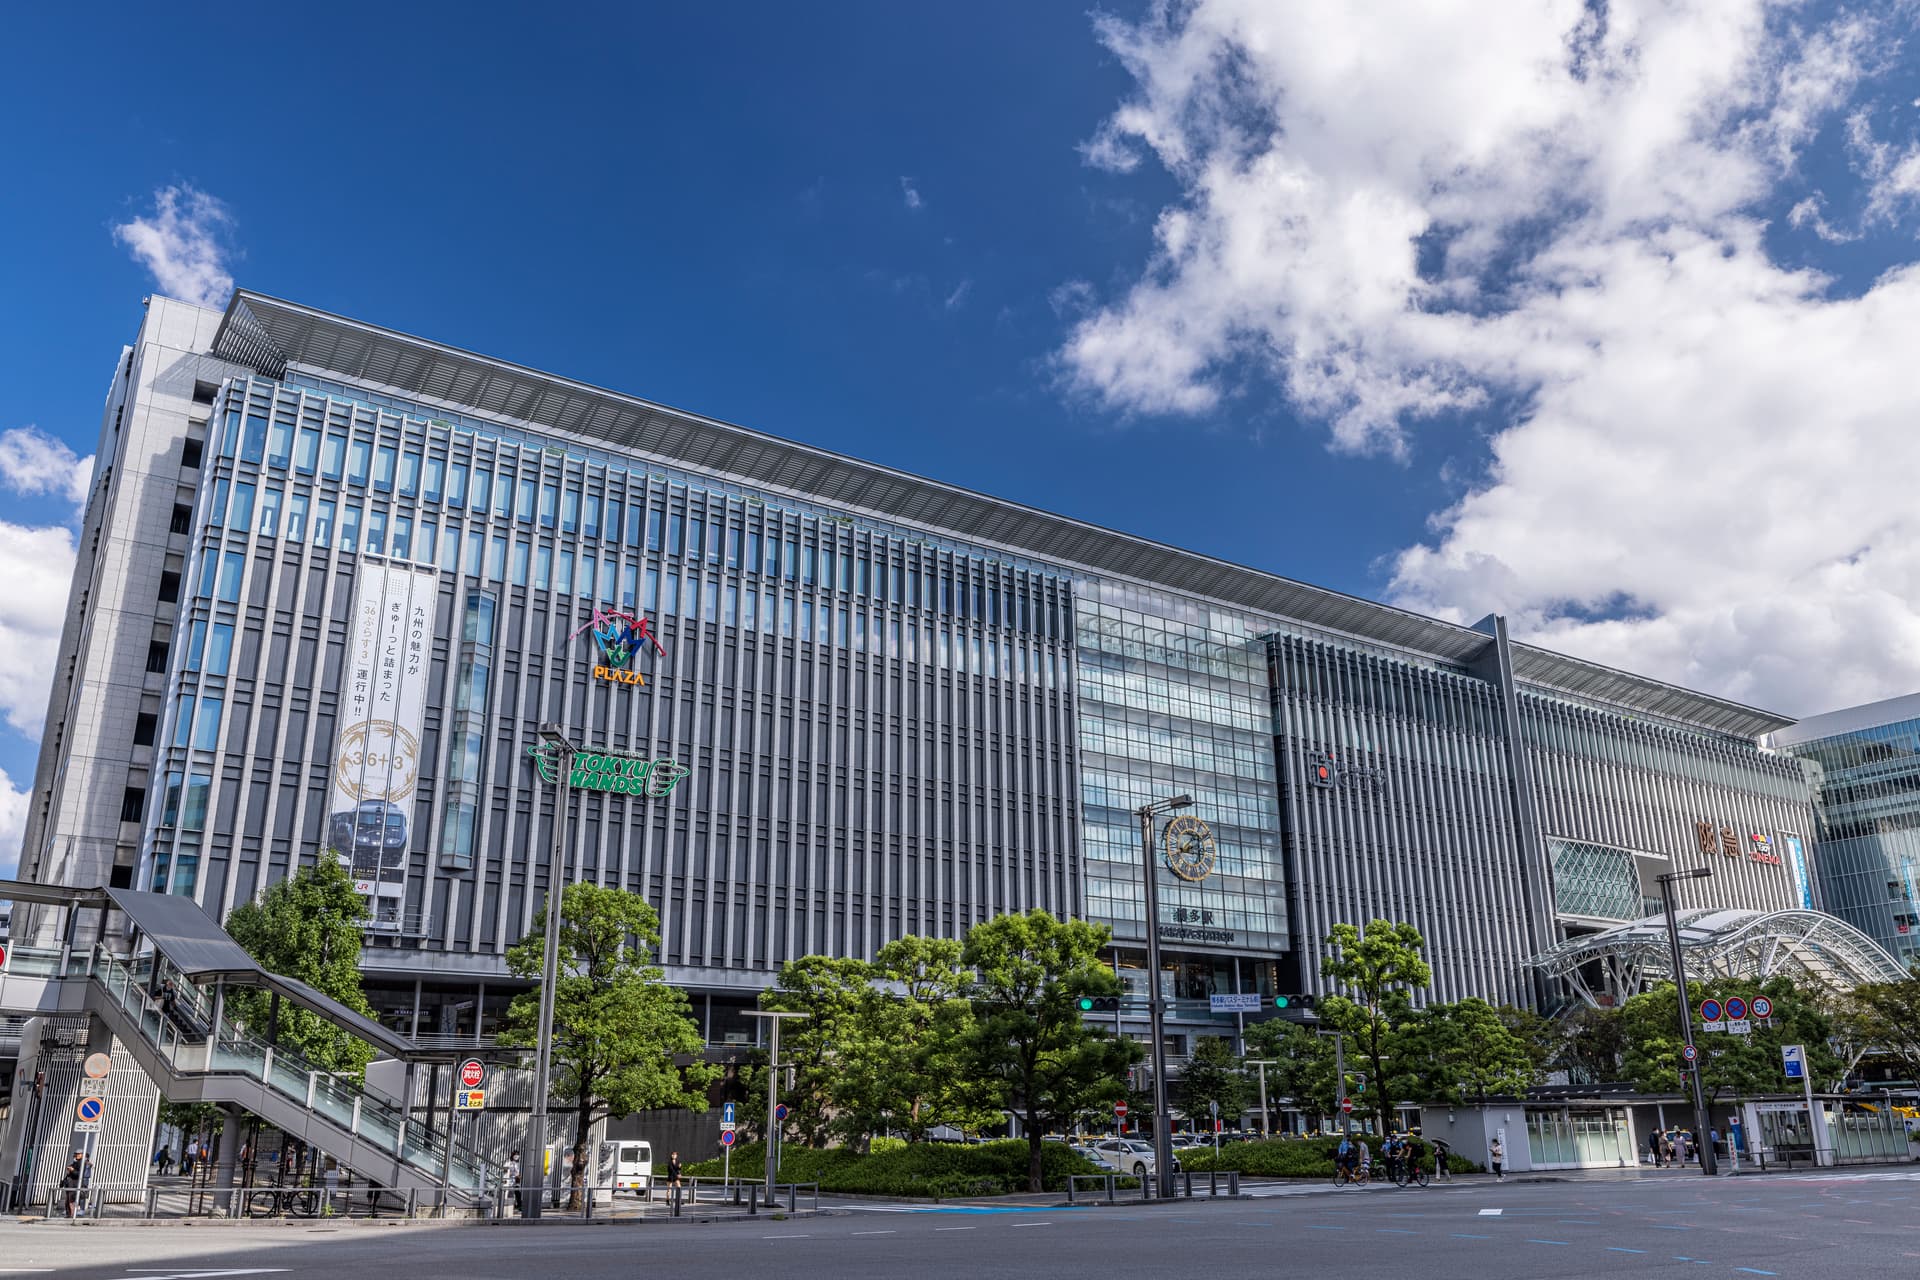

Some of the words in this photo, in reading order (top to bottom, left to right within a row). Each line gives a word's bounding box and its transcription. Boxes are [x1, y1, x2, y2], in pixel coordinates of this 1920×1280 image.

[379, 602, 402, 702] ぎゅーっと詰まった
[407, 606, 425, 676] 九州の魅力が
[594, 664, 645, 686] PLAZA
[352, 751, 404, 773] 36+3
[573, 752, 649, 778] TOKYU
[568, 769, 644, 796] HANDS
[1696, 822, 1740, 857] 阪急
[357, 883, 369, 891] JR
[1173, 908, 1214, 925] 博多駅
[1754, 1001, 1768, 1013] 50
[458, 1092, 469, 1108] 質
